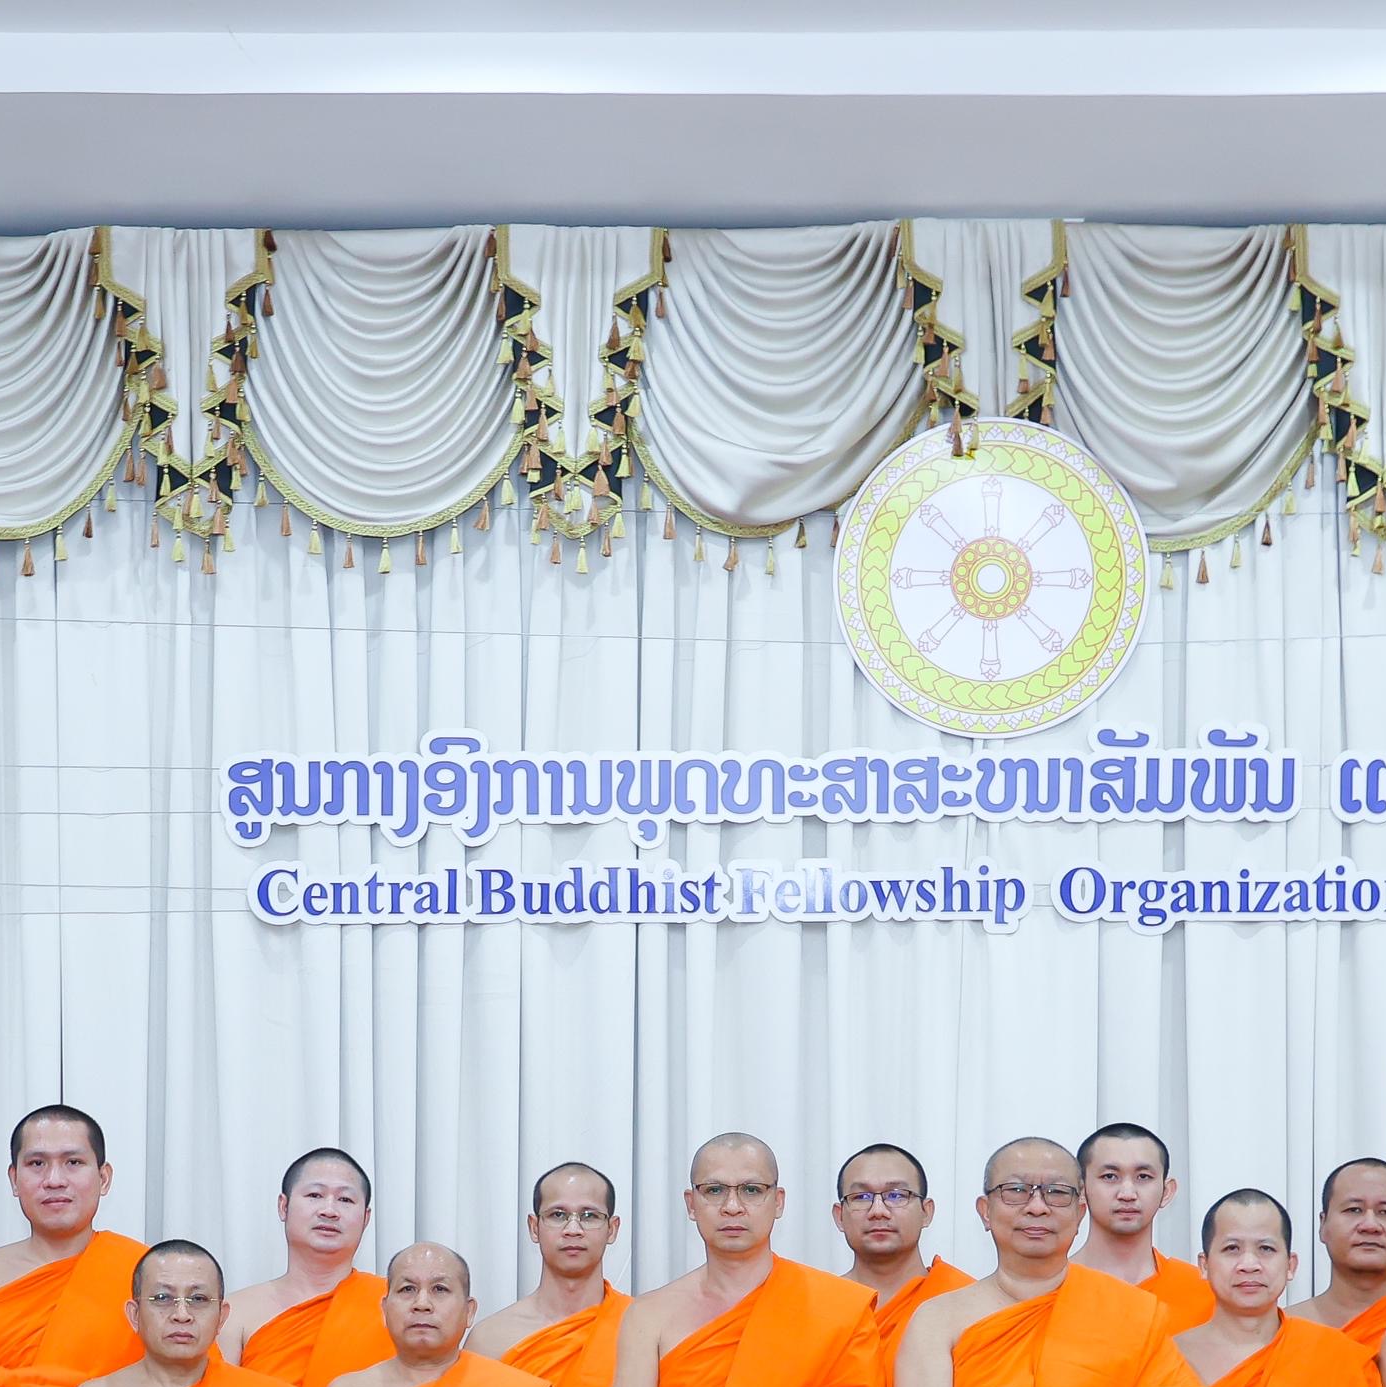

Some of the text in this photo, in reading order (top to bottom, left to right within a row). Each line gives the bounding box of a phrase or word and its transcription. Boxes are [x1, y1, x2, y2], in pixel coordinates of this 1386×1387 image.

[256, 867, 458, 917] Central
[476, 865, 722, 917] Buddhist
[735, 864, 1026, 925] Fellowship
